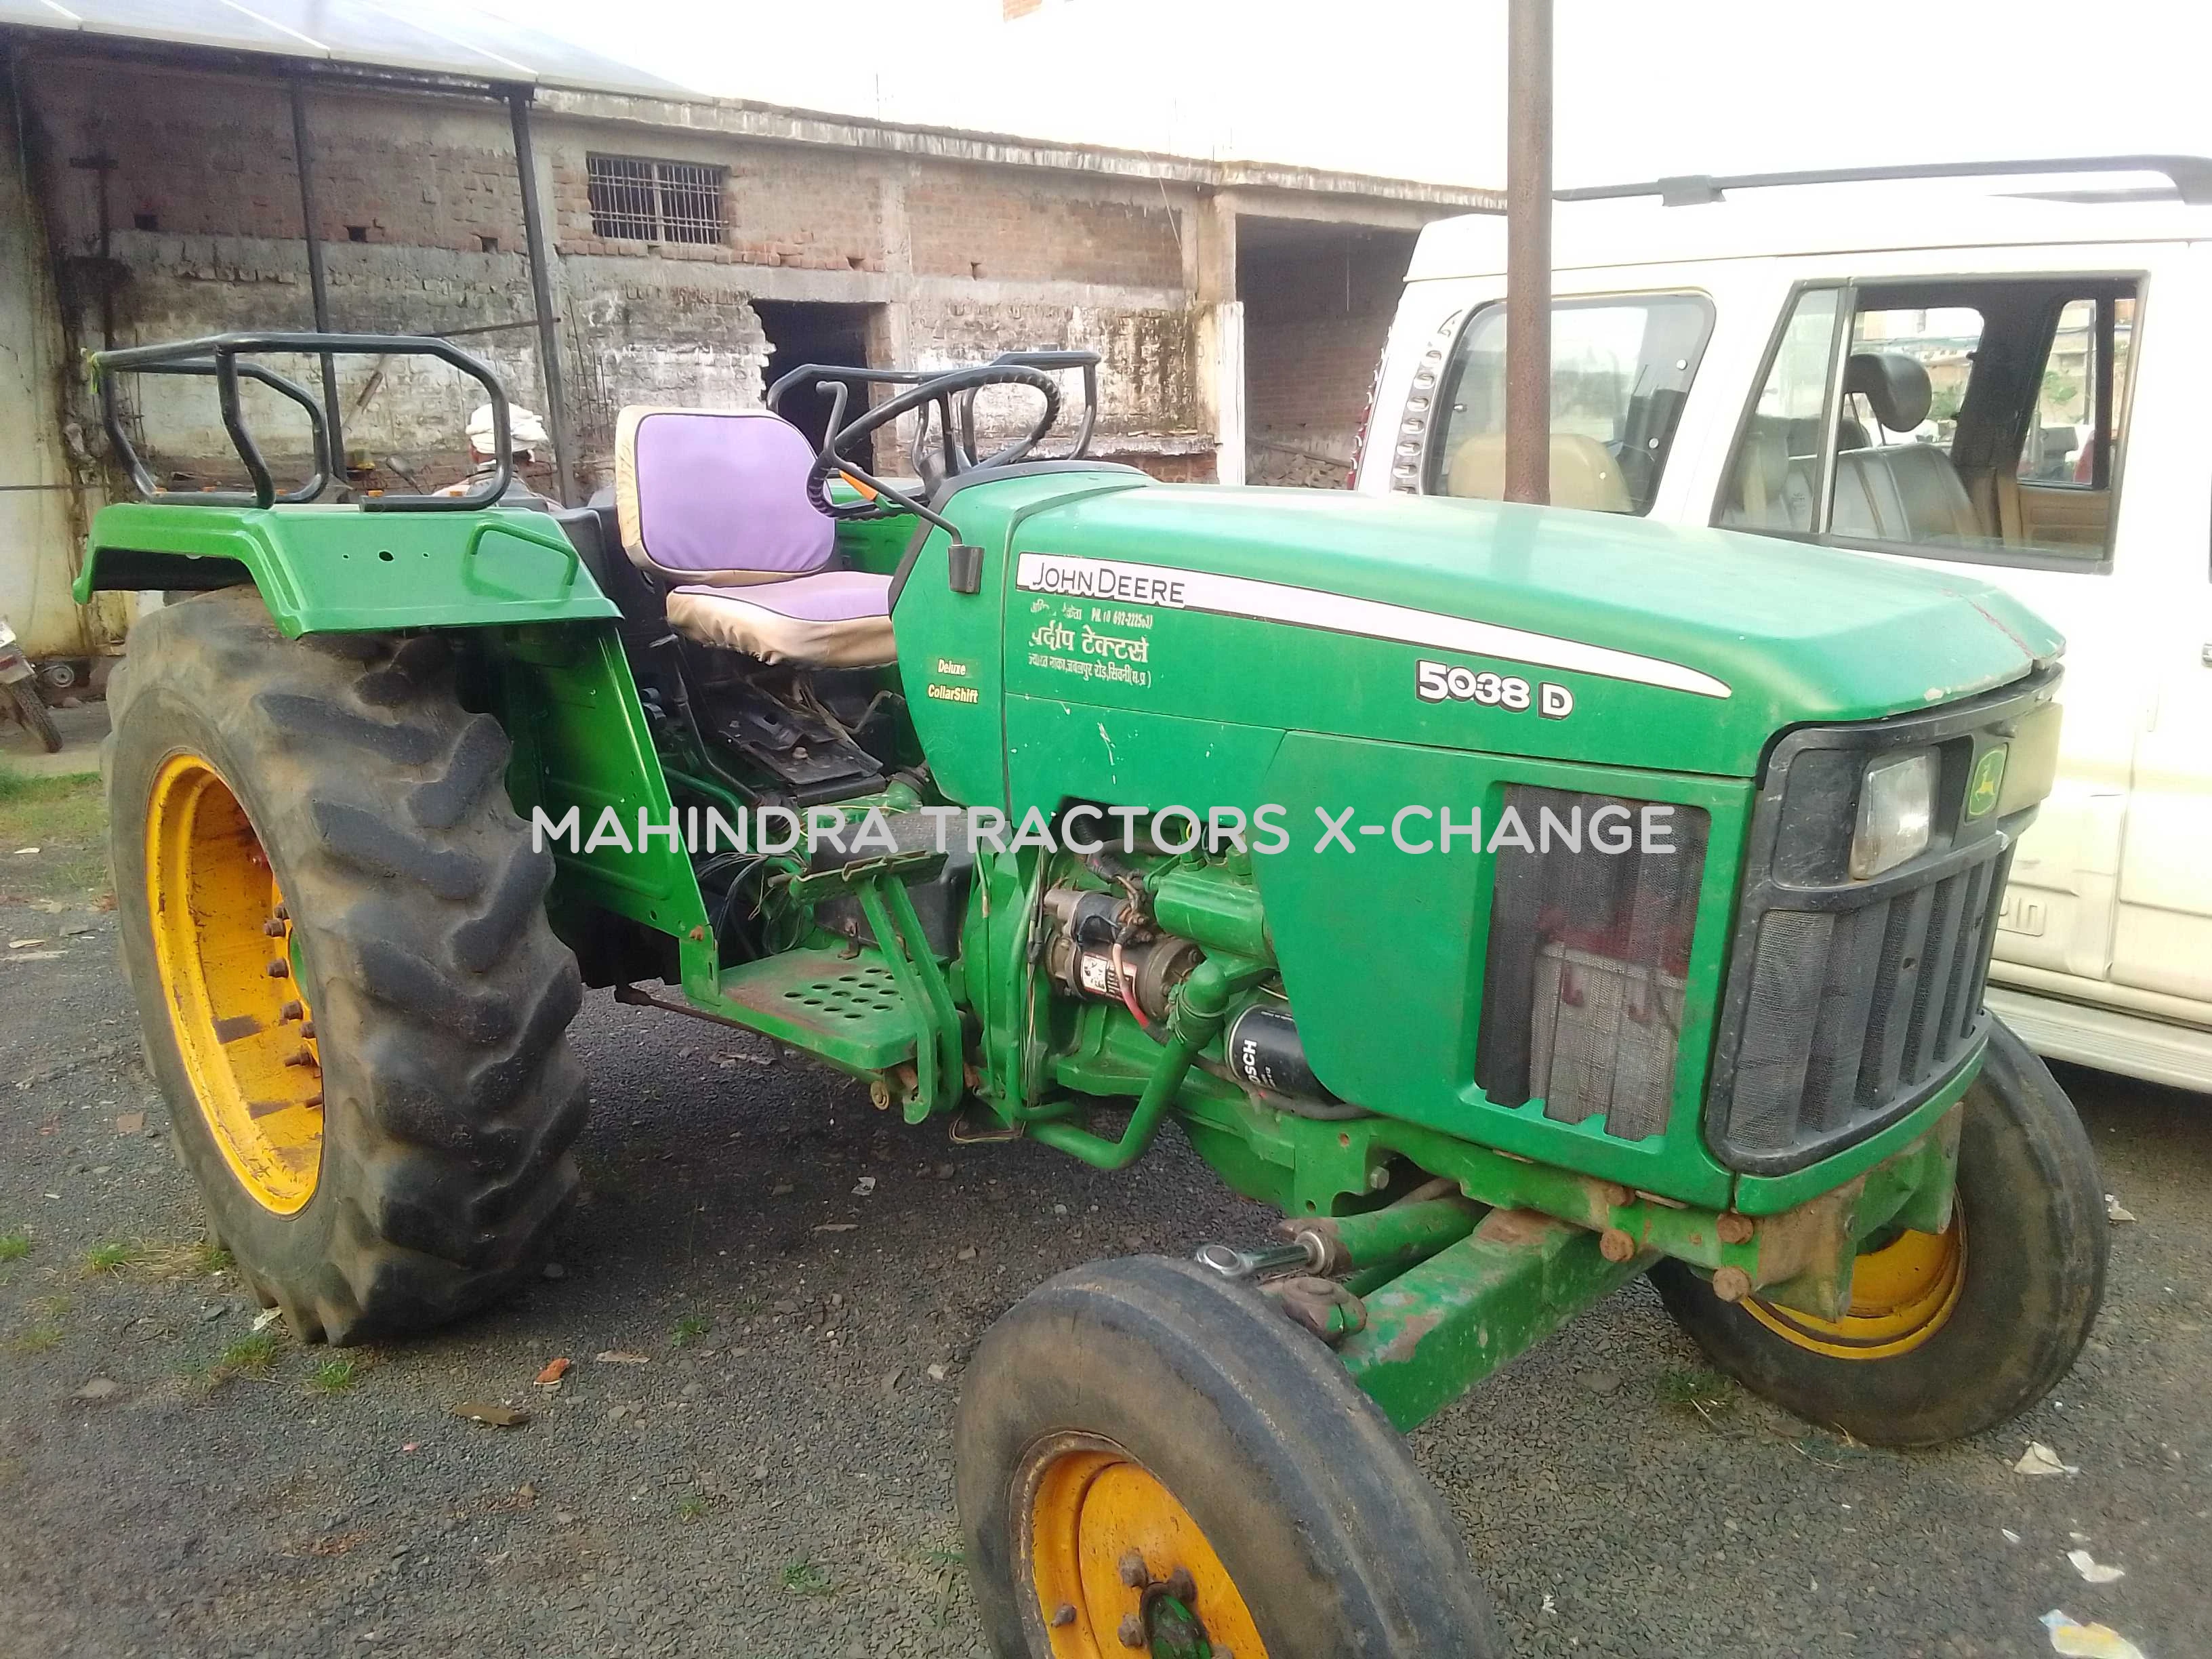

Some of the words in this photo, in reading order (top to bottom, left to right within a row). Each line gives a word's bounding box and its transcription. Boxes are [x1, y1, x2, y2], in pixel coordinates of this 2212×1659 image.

[1032, 562, 1092, 592] JOHN
[1098, 568, 1185, 604] DEERE
[938, 659, 966, 676] Deluxe
[928, 684, 979, 704] CollarShift
[1416, 659, 1531, 713] 5038
[1538, 682, 1574, 721] D
[1242, 1039, 1261, 1084] OSCH
